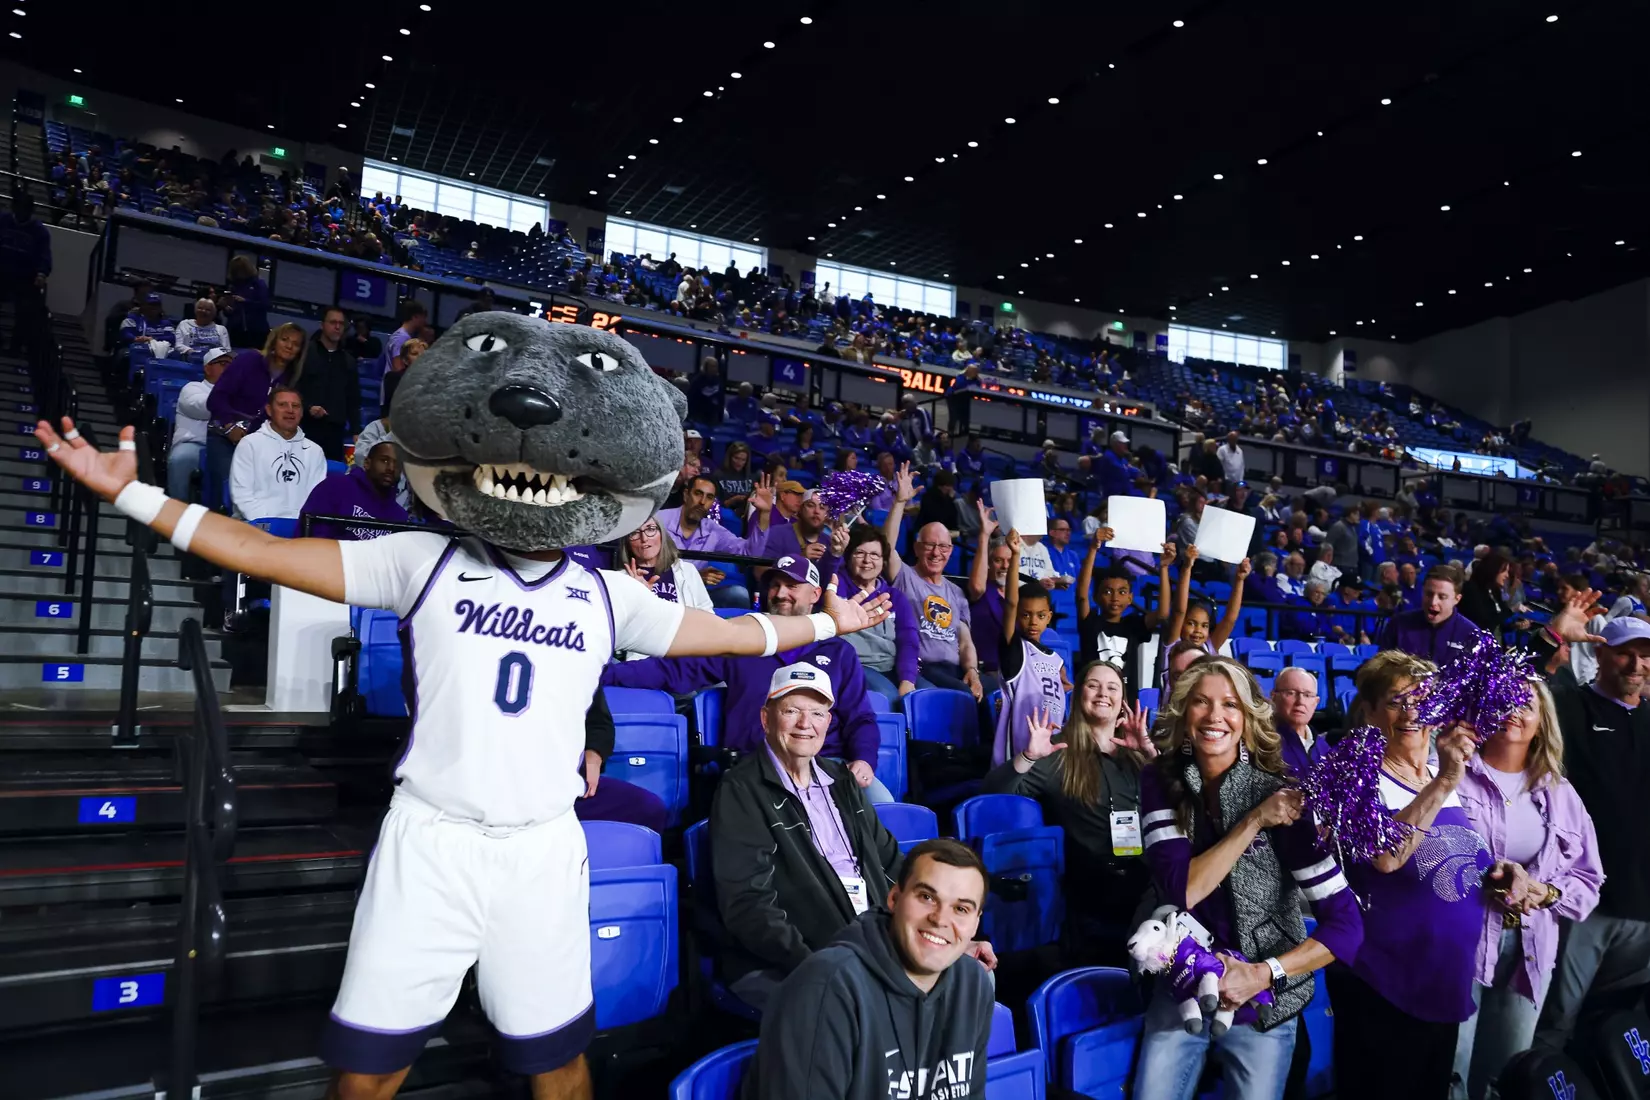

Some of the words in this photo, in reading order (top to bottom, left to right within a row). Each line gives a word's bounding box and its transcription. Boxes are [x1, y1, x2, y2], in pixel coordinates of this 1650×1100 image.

[355, 279, 371, 298] 3
[782, 364, 796, 380] 4
[25, 450, 39, 459] 10
[1324, 460, 1333, 473] 6
[32, 481, 41, 490] 9
[35, 514, 46, 524] 8
[42, 554, 52, 564] 7
[48, 604, 60, 615] 6
[455, 599, 586, 652] Wildcats
[57, 667, 70, 679] 5
[493, 650, 535, 717] 0
[1041, 676, 1061, 701] 22
[98, 801, 117, 819] 4
[119, 981, 139, 1004] 3
